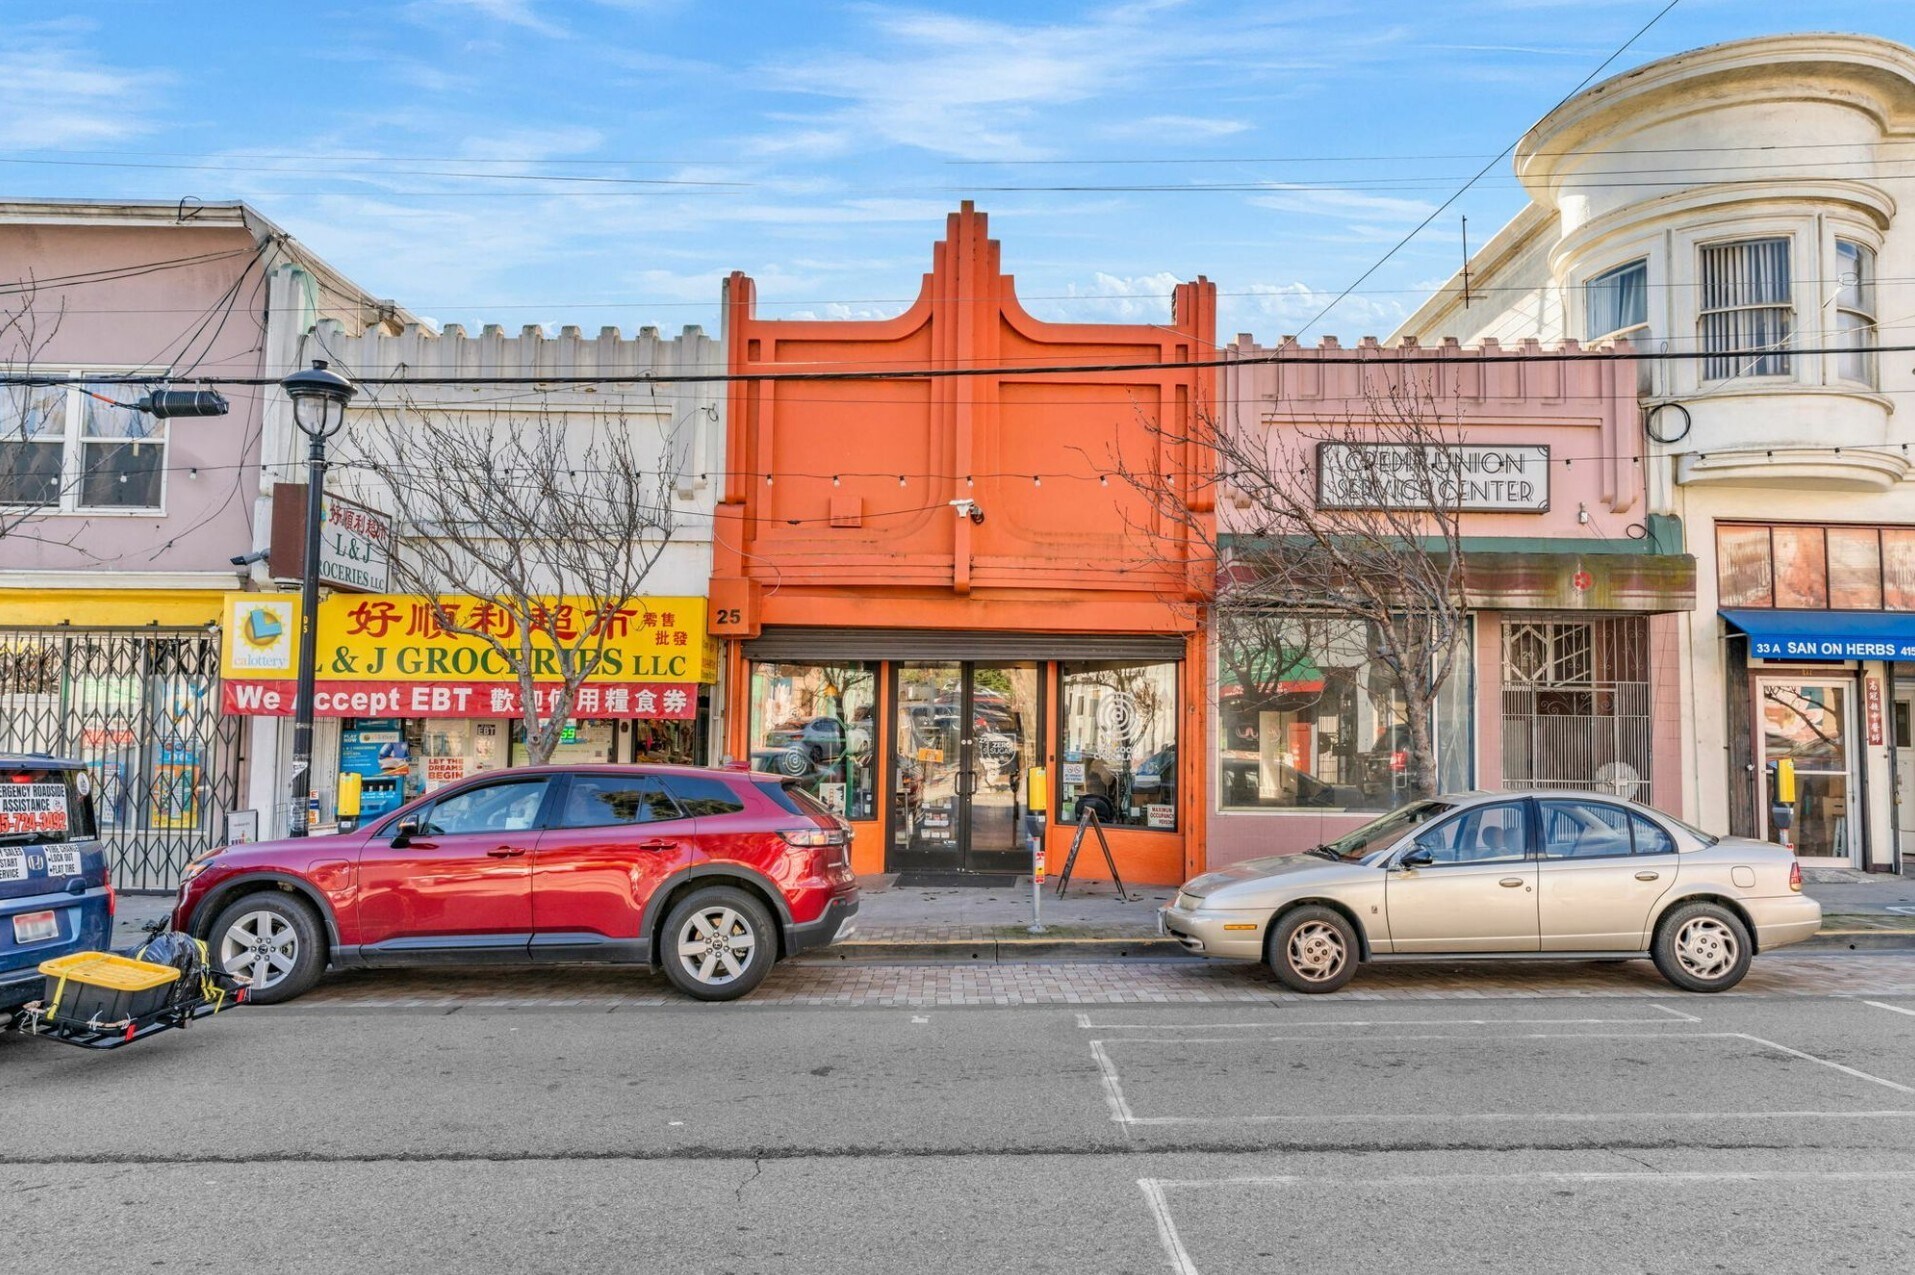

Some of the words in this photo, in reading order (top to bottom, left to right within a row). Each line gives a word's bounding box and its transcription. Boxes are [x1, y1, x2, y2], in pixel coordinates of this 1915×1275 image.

[1345, 451, 1426, 474] CREDI
[1435, 452, 1525, 474] UNION
[1438, 480, 1535, 502] CENTER
[336, 533, 346, 557] L
[348, 538, 360, 560] &
[362, 541, 374, 564] J
[319, 560, 369, 587] OCERIES
[370, 577, 385, 591] LLC
[346, 601, 638, 641] 好順利超市
[643, 612, 676, 628] 零售
[716, 608, 741, 625] 25
[655, 630, 688, 646] 批發
[1756, 643, 1770, 654] 33
[1772, 645, 1781, 654] A
[1787, 642, 1817, 655] SAN
[1821, 643, 1843, 655] ON
[1846, 643, 1896, 656] HERBS
[234, 655, 286, 669] calottery
[332, 646, 359, 674] &
[366, 647, 388, 674] J
[632, 655, 686, 676] LLC
[235, 684, 281, 711] We
[290, 687, 400, 716] ccept
[412, 687, 473, 712] EBT
[428, 771, 464, 780] BEGIN
[33, 784, 65, 798] ROADSIDE
[3, 799, 50, 813] ASSISTANCE
[6, 846, 24, 857] SALES
